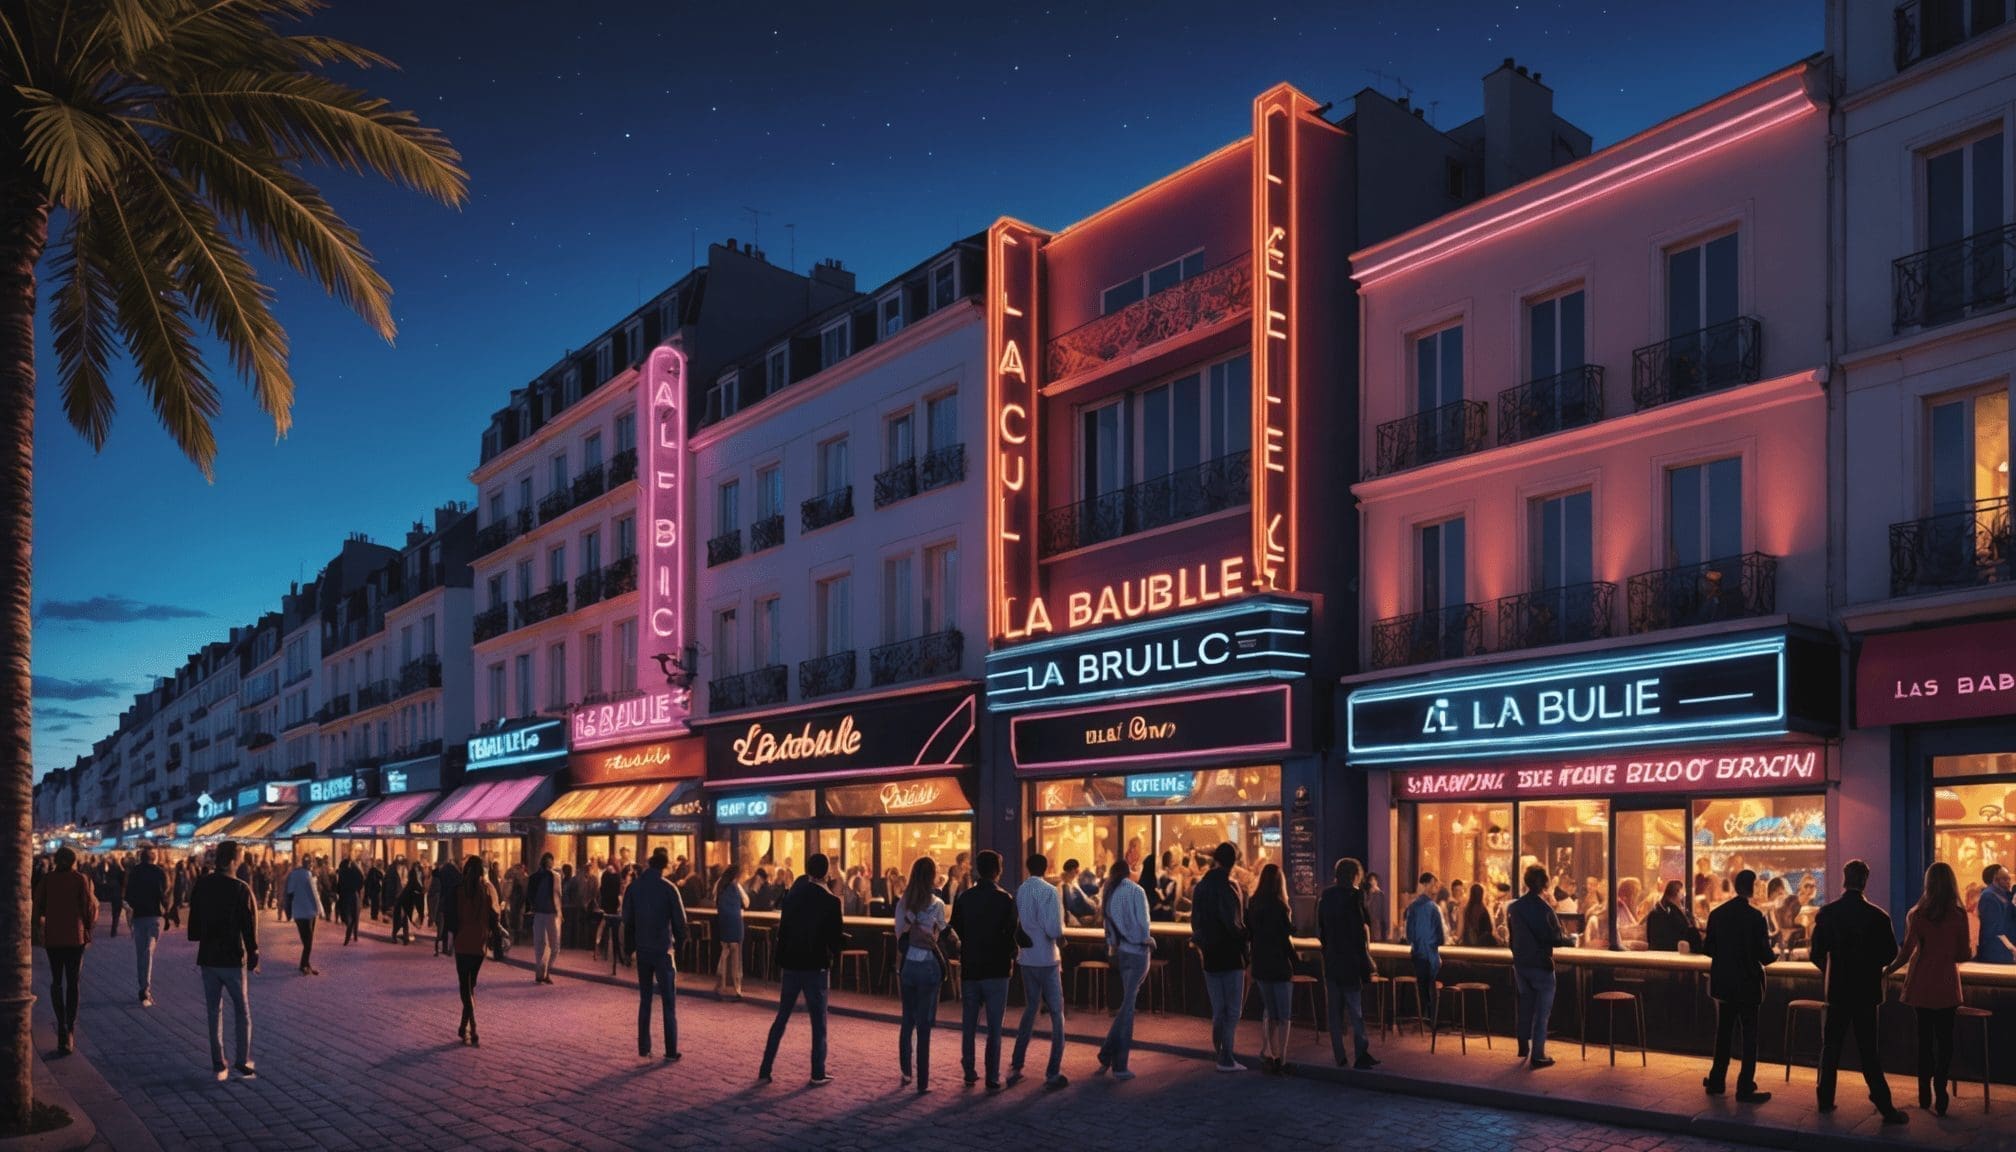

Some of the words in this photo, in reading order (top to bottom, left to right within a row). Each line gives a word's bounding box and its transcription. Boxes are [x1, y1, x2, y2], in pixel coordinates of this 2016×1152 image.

[1003, 596, 1053, 639] LA
[1026, 661, 1065, 691] LA
[1894, 679, 1939, 699] LAS
[1472, 695, 1526, 730] LA
